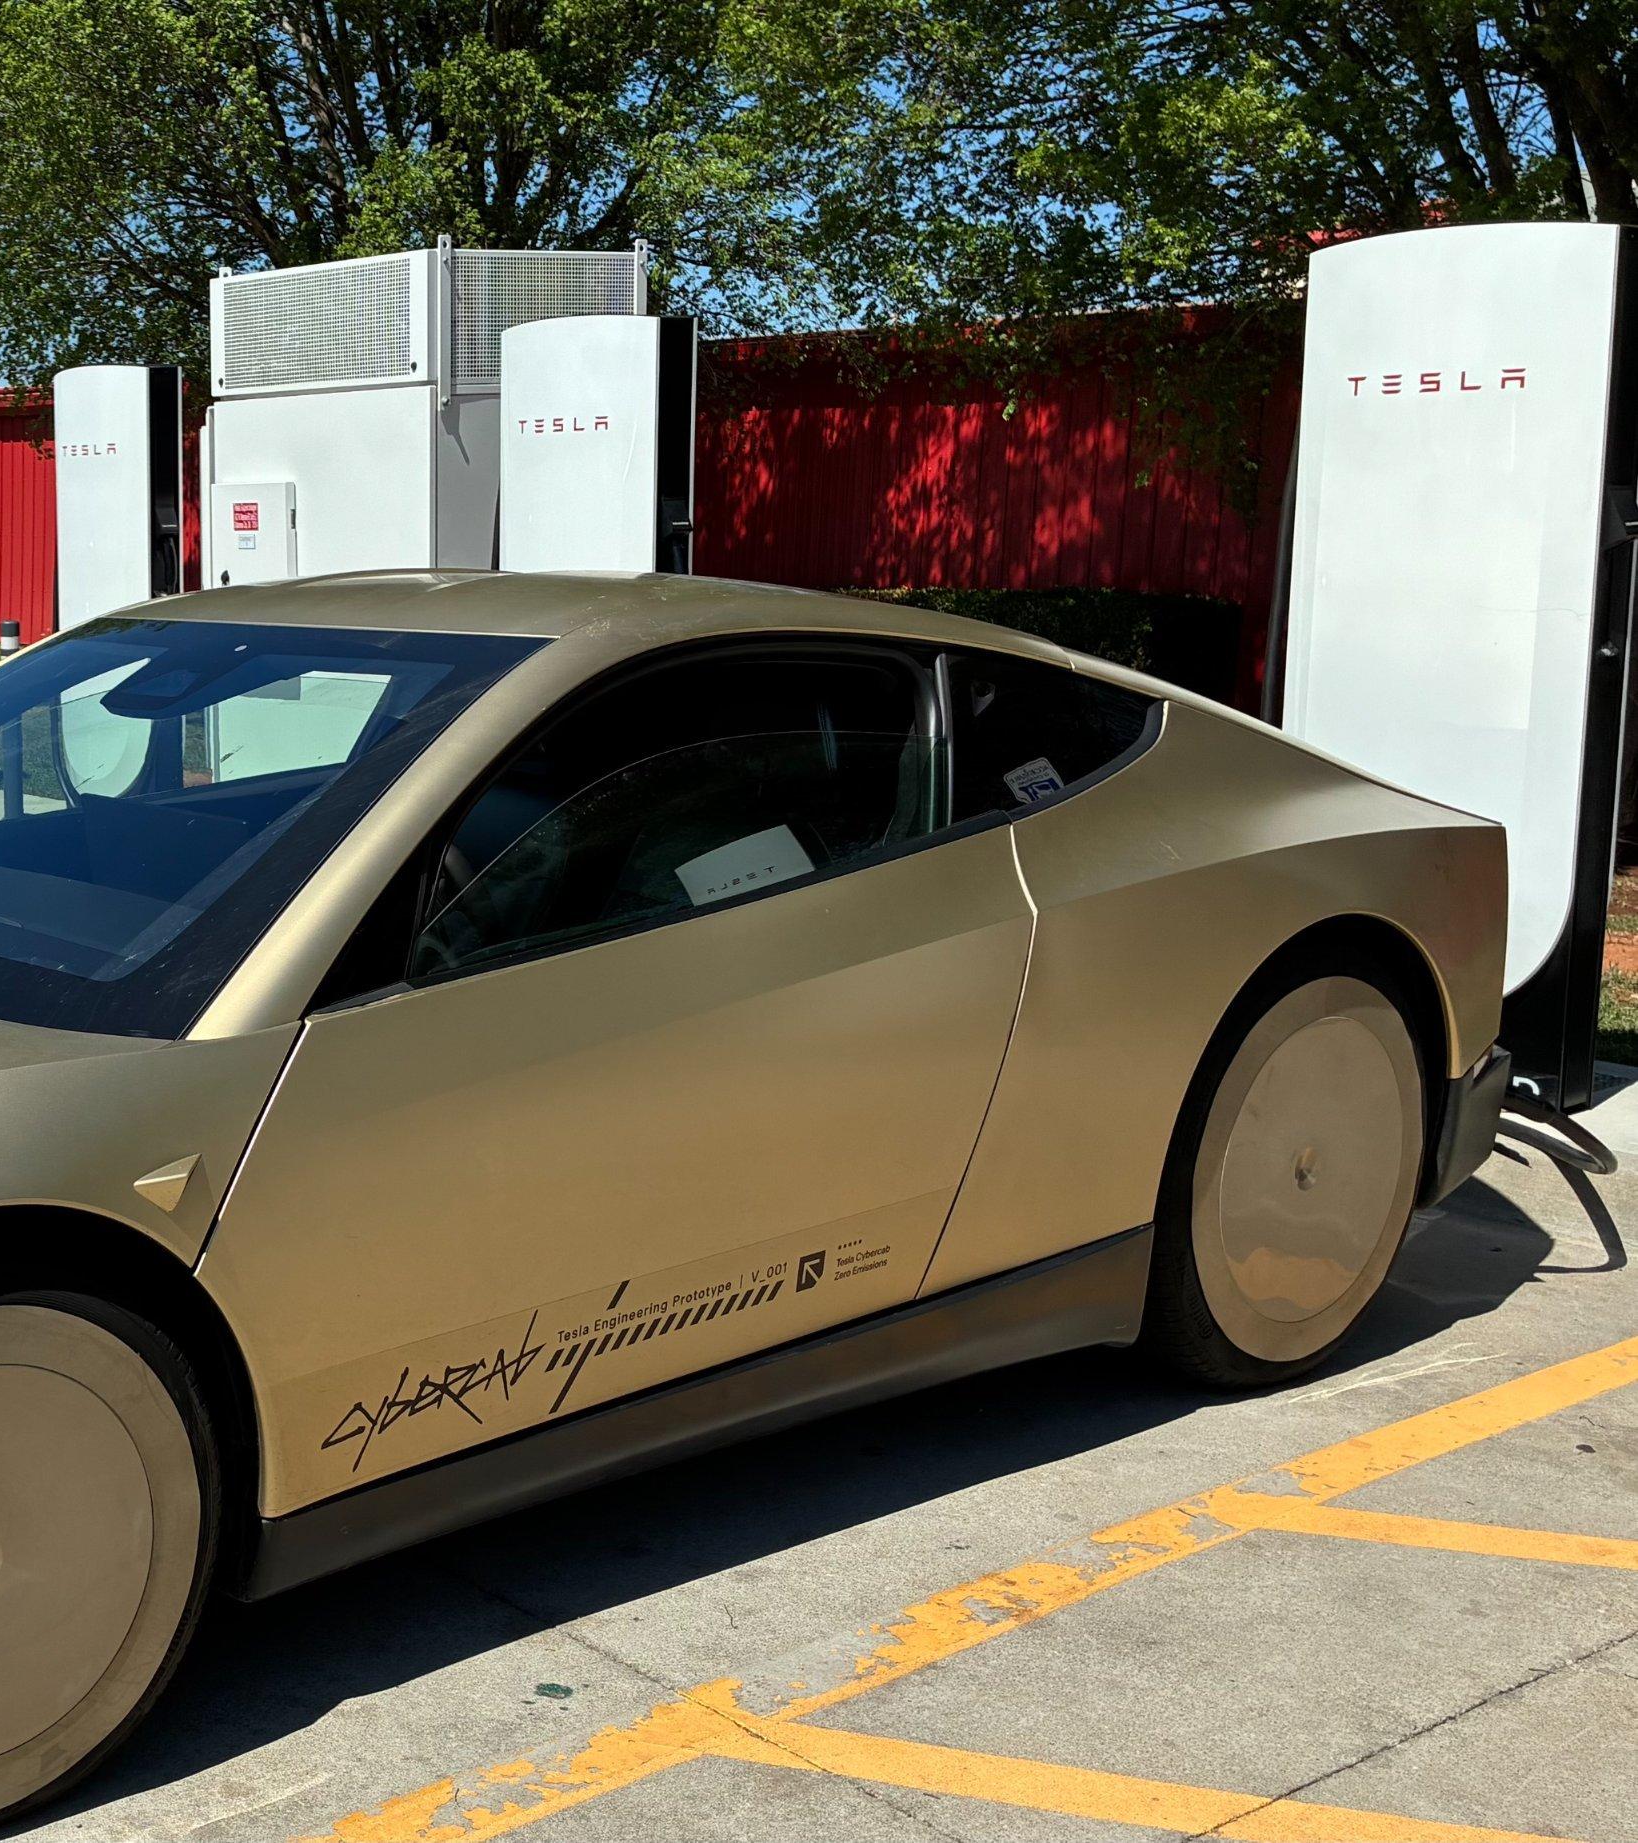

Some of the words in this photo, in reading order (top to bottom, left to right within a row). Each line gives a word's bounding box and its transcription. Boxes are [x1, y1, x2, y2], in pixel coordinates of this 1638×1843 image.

[1347, 368, 1526, 396] TESLA
[518, 416, 608, 434] TESLA
[62, 443, 116, 457] TESLA
[836, 1256, 854, 1268] Tesla
[855, 1244, 891, 1261] Cybercab
[833, 1270, 851, 1281] Zero
[852, 1258, 888, 1275] Emissions
[557, 1327, 589, 1343] Tesla
[594, 1301, 668, 1331] Engineering
[672, 1281, 732, 1308] Prototype
[751, 1261, 788, 1284] V_001
